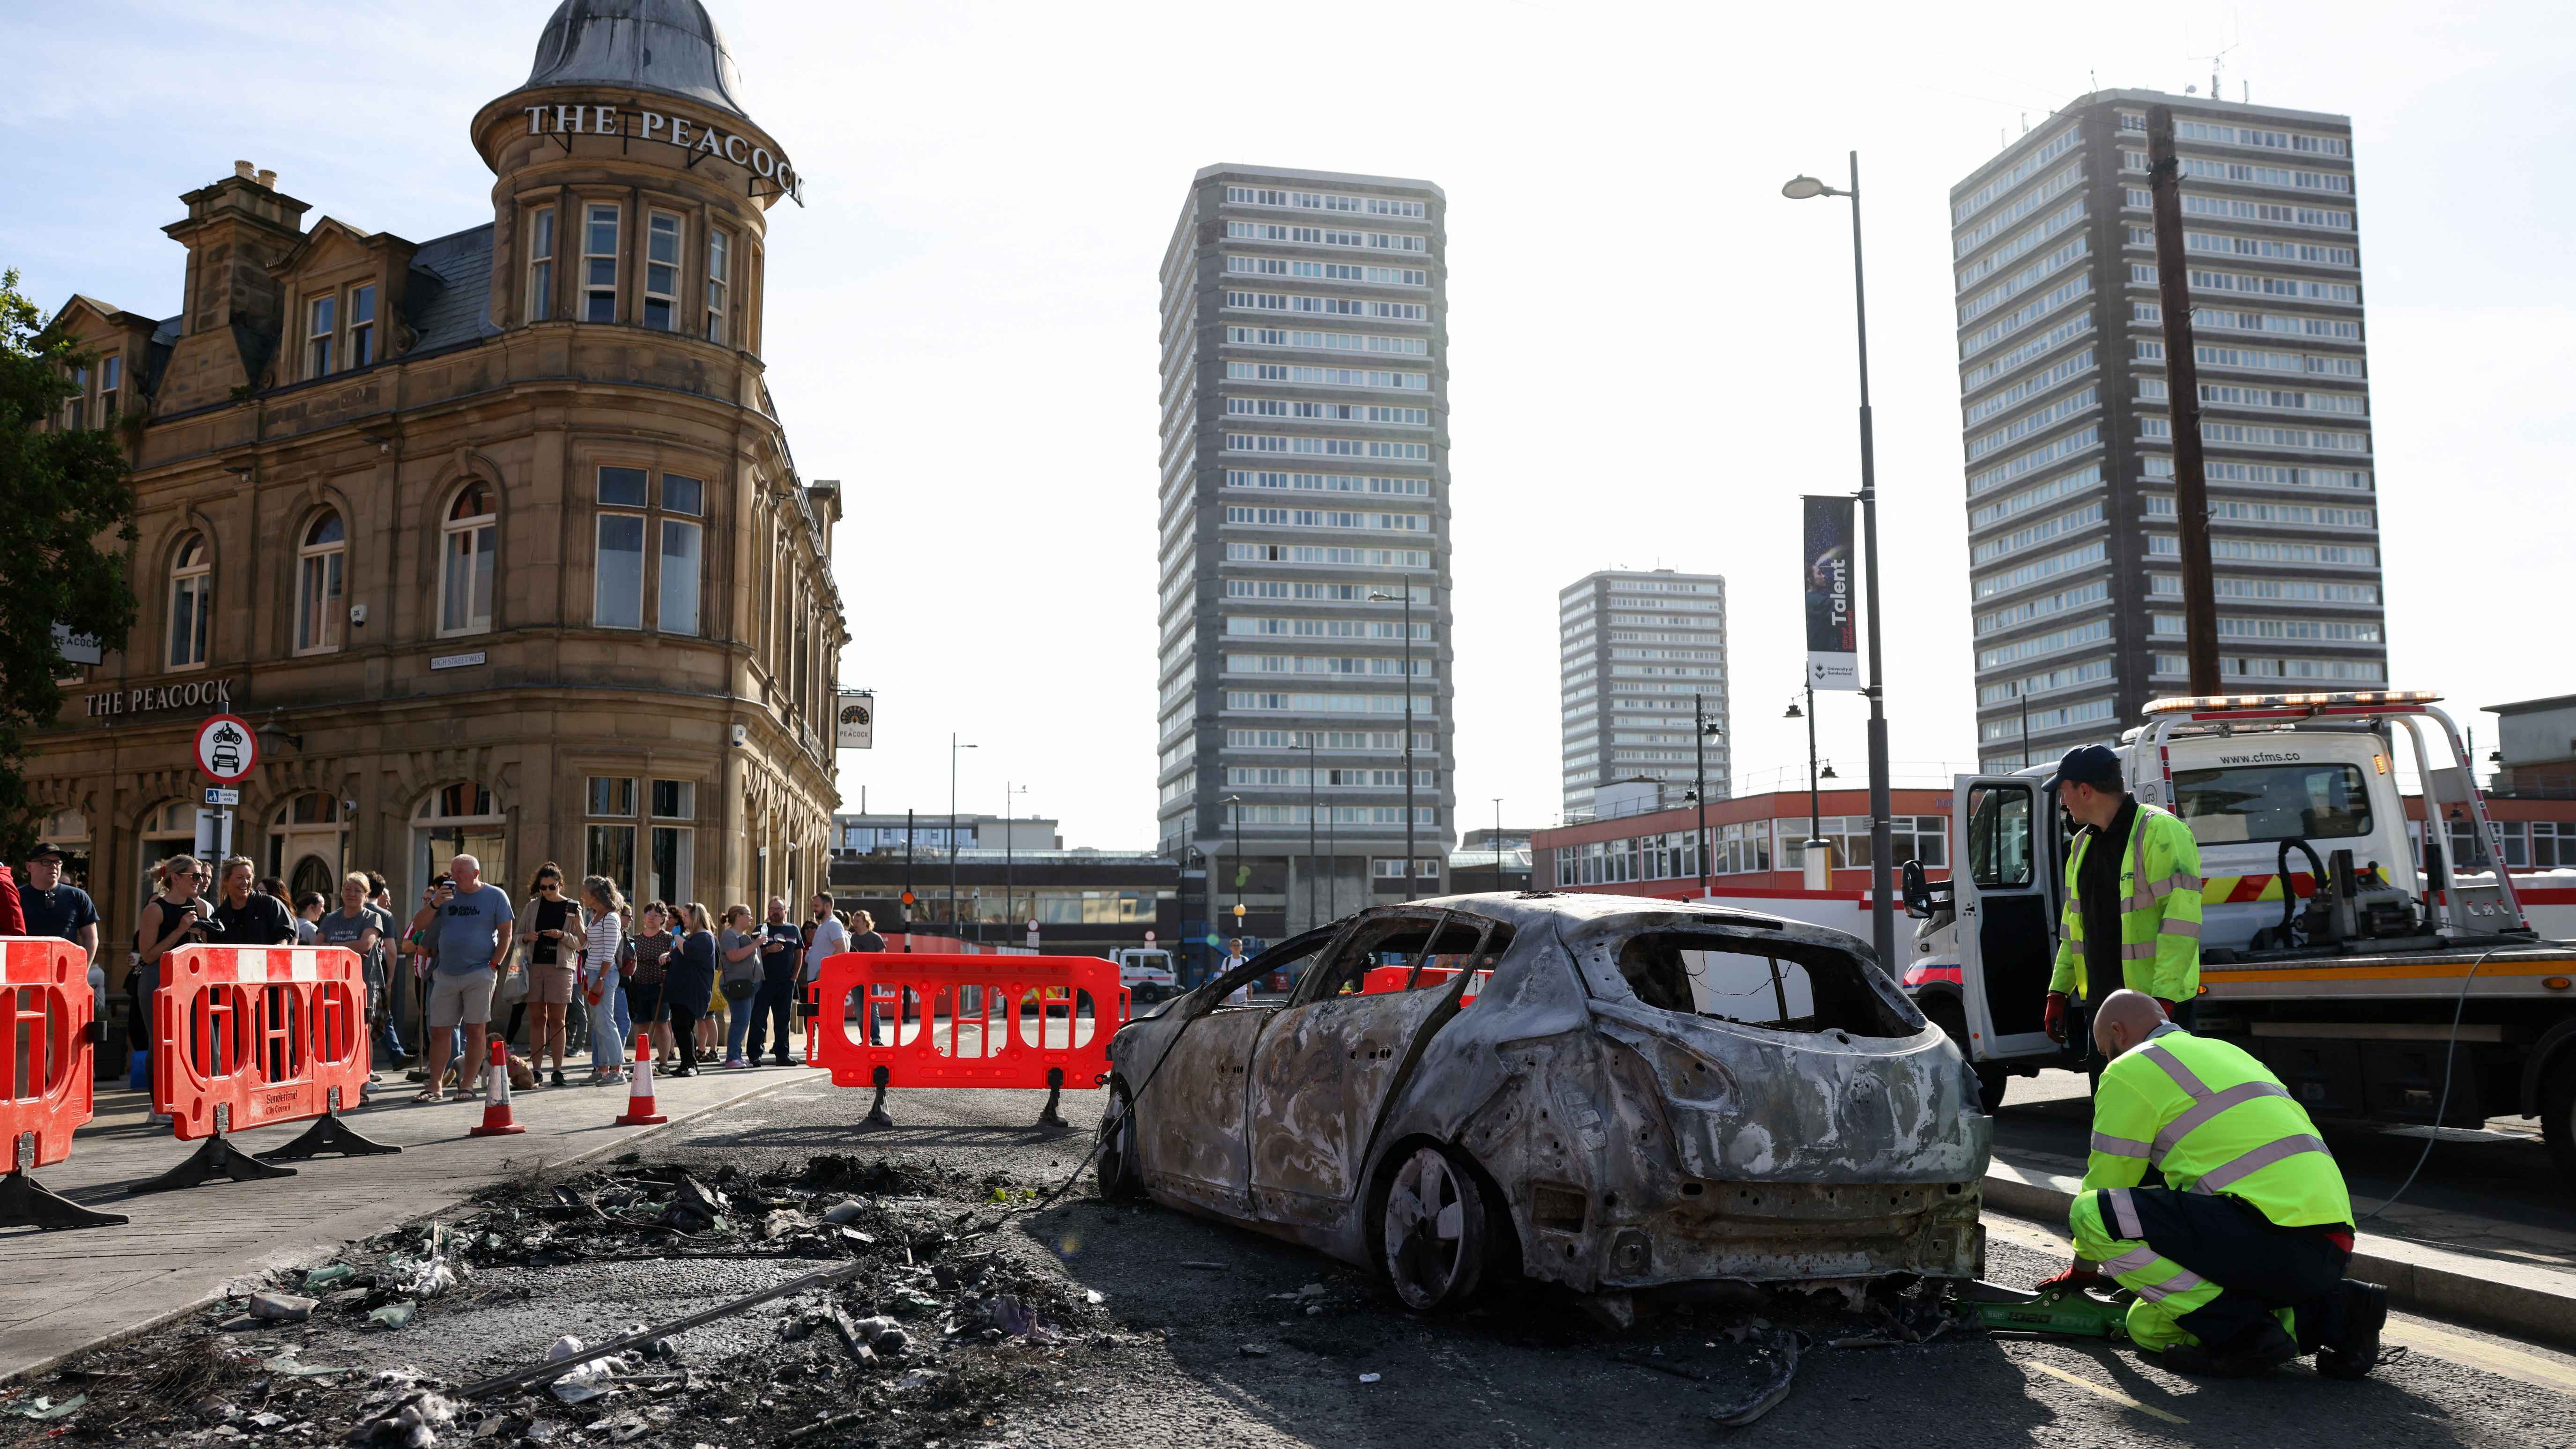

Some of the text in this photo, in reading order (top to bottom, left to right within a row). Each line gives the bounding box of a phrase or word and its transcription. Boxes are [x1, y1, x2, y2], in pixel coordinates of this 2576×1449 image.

[525, 105, 806, 208] THE PEACOCK
[1830, 559, 1847, 626] Talent
[432, 654, 484, 667] HIGH STREET WEST
[85, 679, 231, 717] THE PEACOCK
[2220, 752, 2300, 764] www.cfms.co
[2146, 793, 2155, 803] LT3
[266, 1089, 297, 1104] Sunderland
[266, 1103, 290, 1116] City Council
